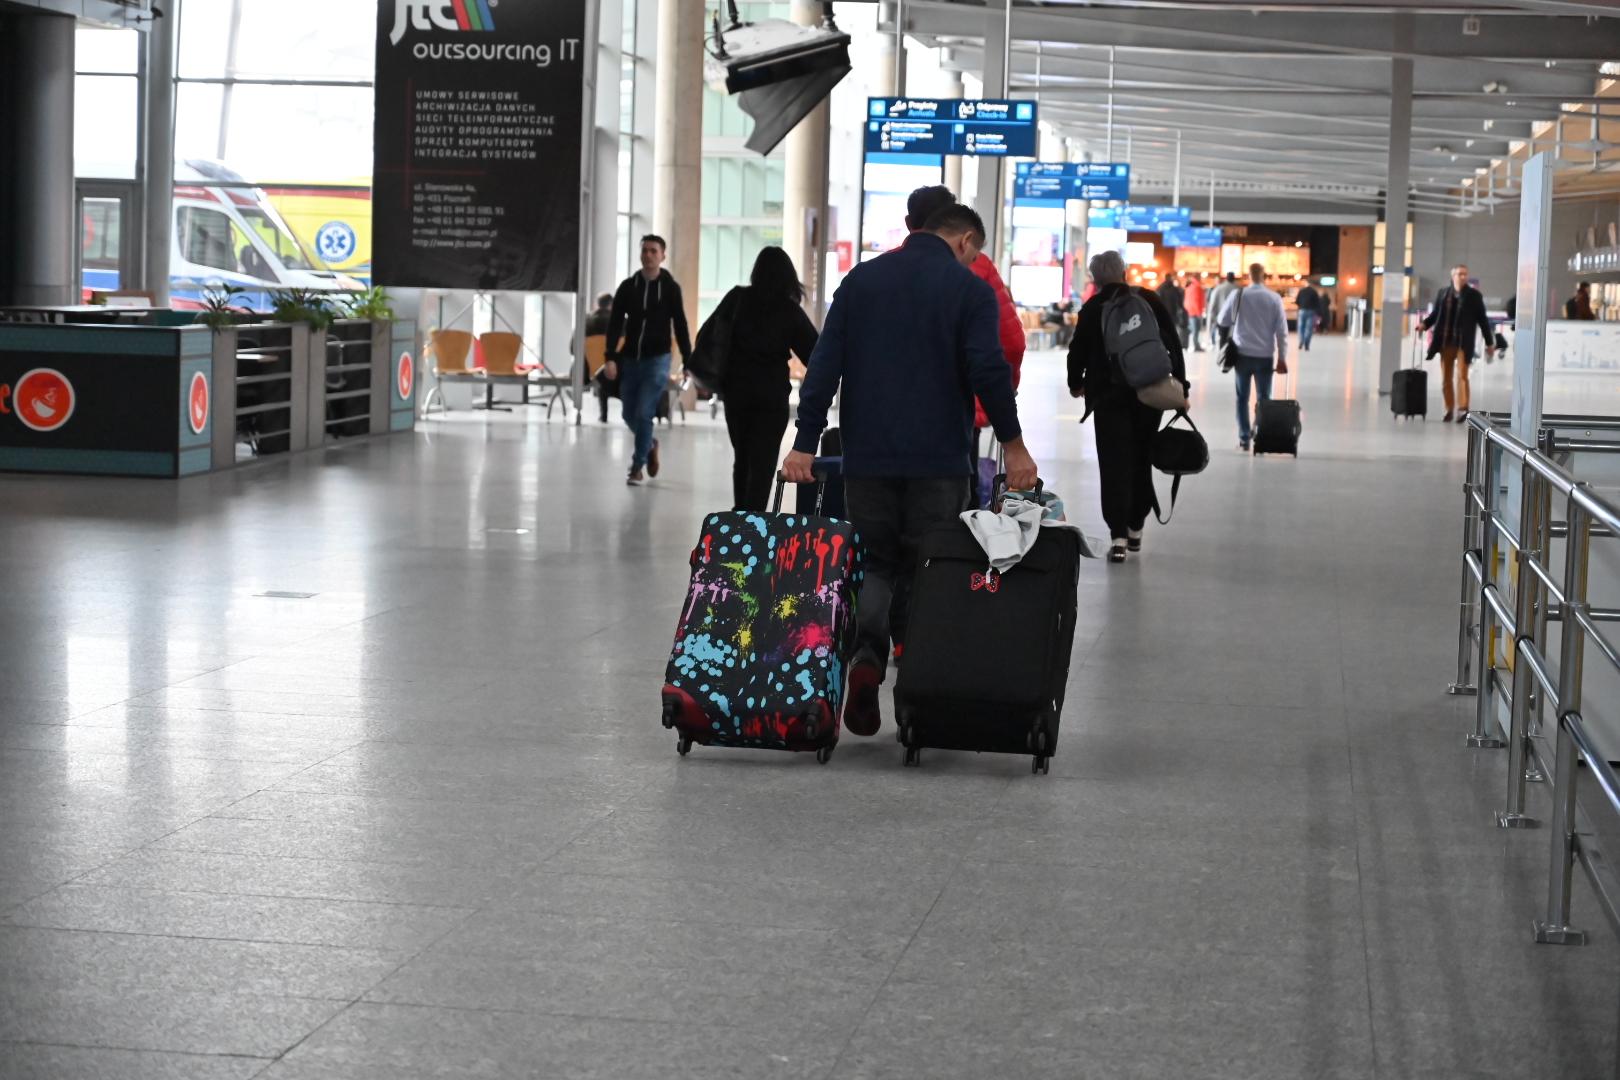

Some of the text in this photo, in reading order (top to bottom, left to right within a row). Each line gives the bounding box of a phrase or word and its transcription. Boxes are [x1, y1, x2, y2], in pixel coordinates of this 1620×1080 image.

[413, 39, 579, 67] outsourcing IT
[416, 90, 519, 100] UMOWY SERWISOWE
[416, 102, 536, 112] ARCHIWIZACJA DANYCH
[415, 113, 555, 124] SIECI TELEINFORMATYCZNE
[415, 125, 553, 136] AUDYTY OPROGRAMOWANIA
[415, 137, 534, 147] SPRZĘT KOMPUTEROWY
[414, 149, 537, 159] INTEGRACJA SYSTEMÓW
